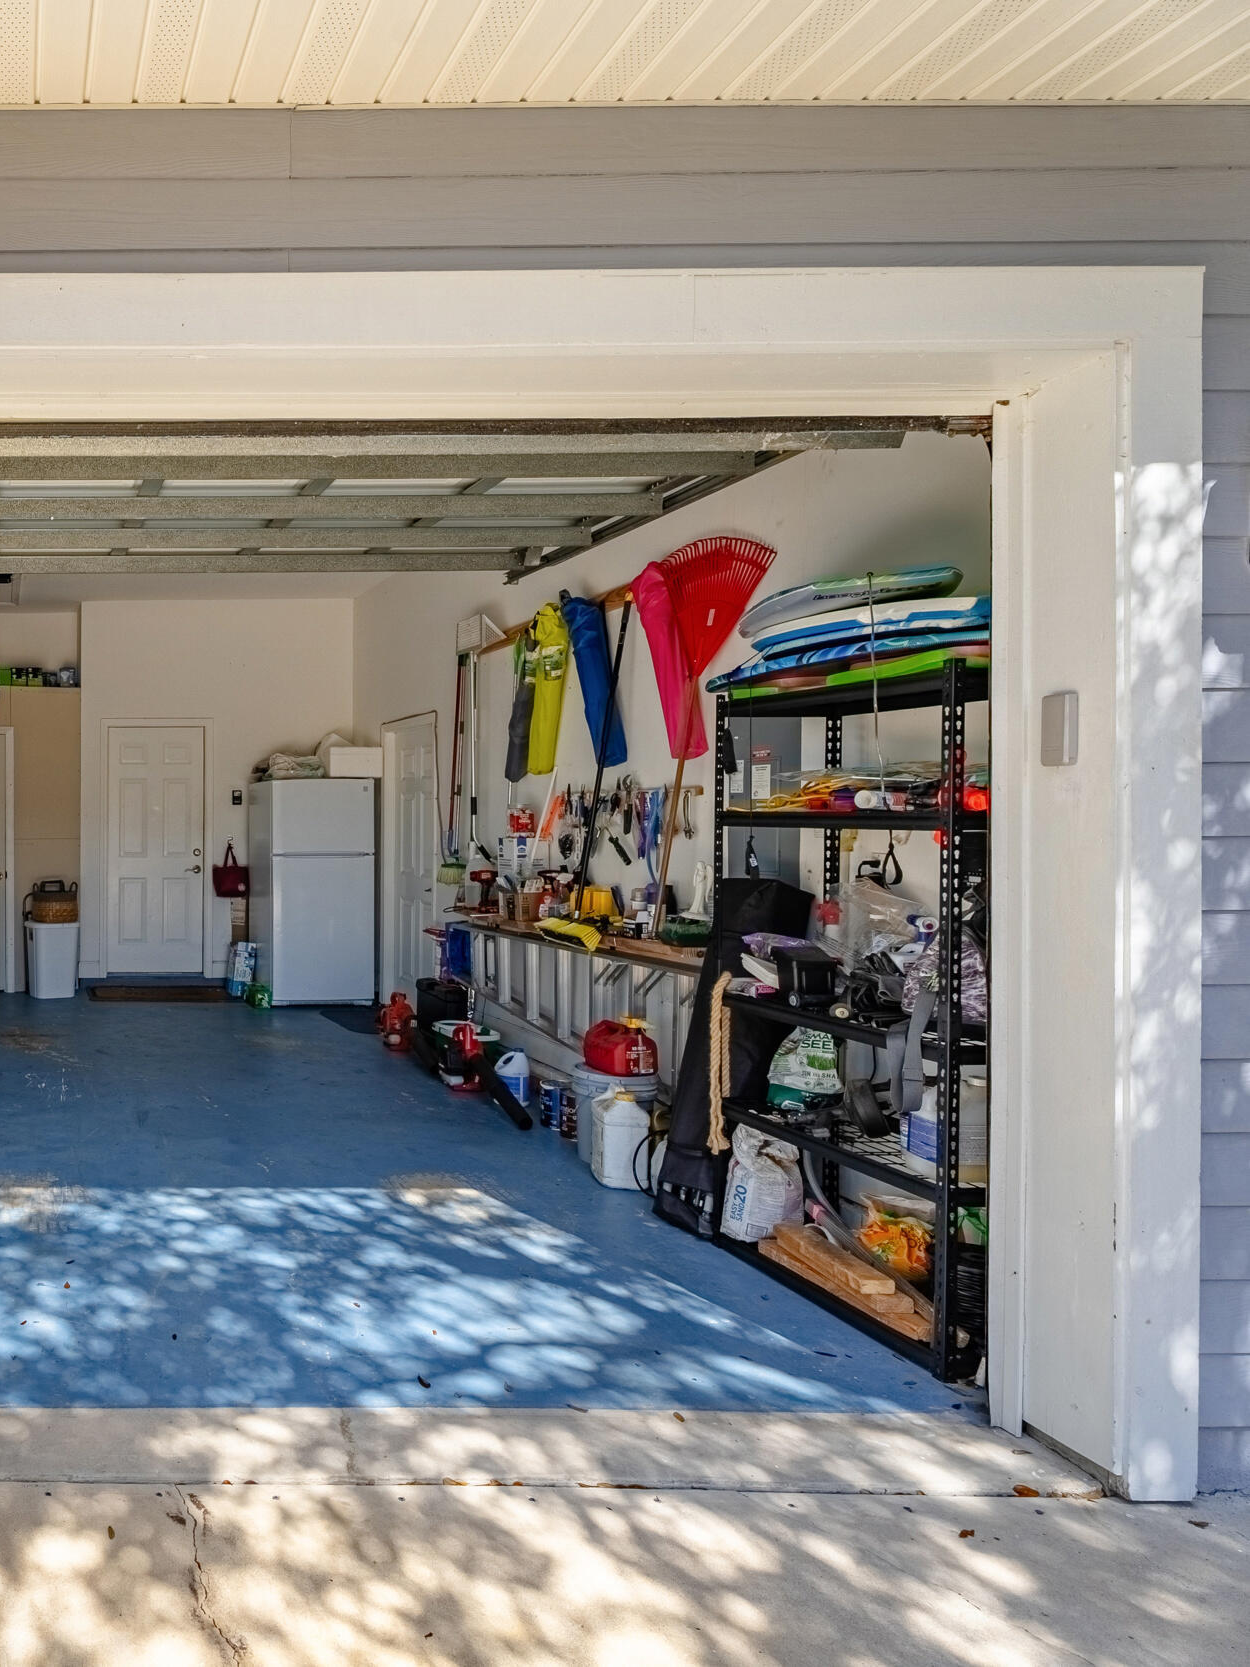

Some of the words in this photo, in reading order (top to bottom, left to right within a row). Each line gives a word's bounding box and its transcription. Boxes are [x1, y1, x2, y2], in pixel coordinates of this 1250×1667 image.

[800, 1039, 833, 1050] SEE
[805, 1033, 832, 1041] SMA
[734, 1184, 747, 1203] 20
[730, 1202, 738, 1220] EASY
[735, 1202, 745, 1222] SAND
